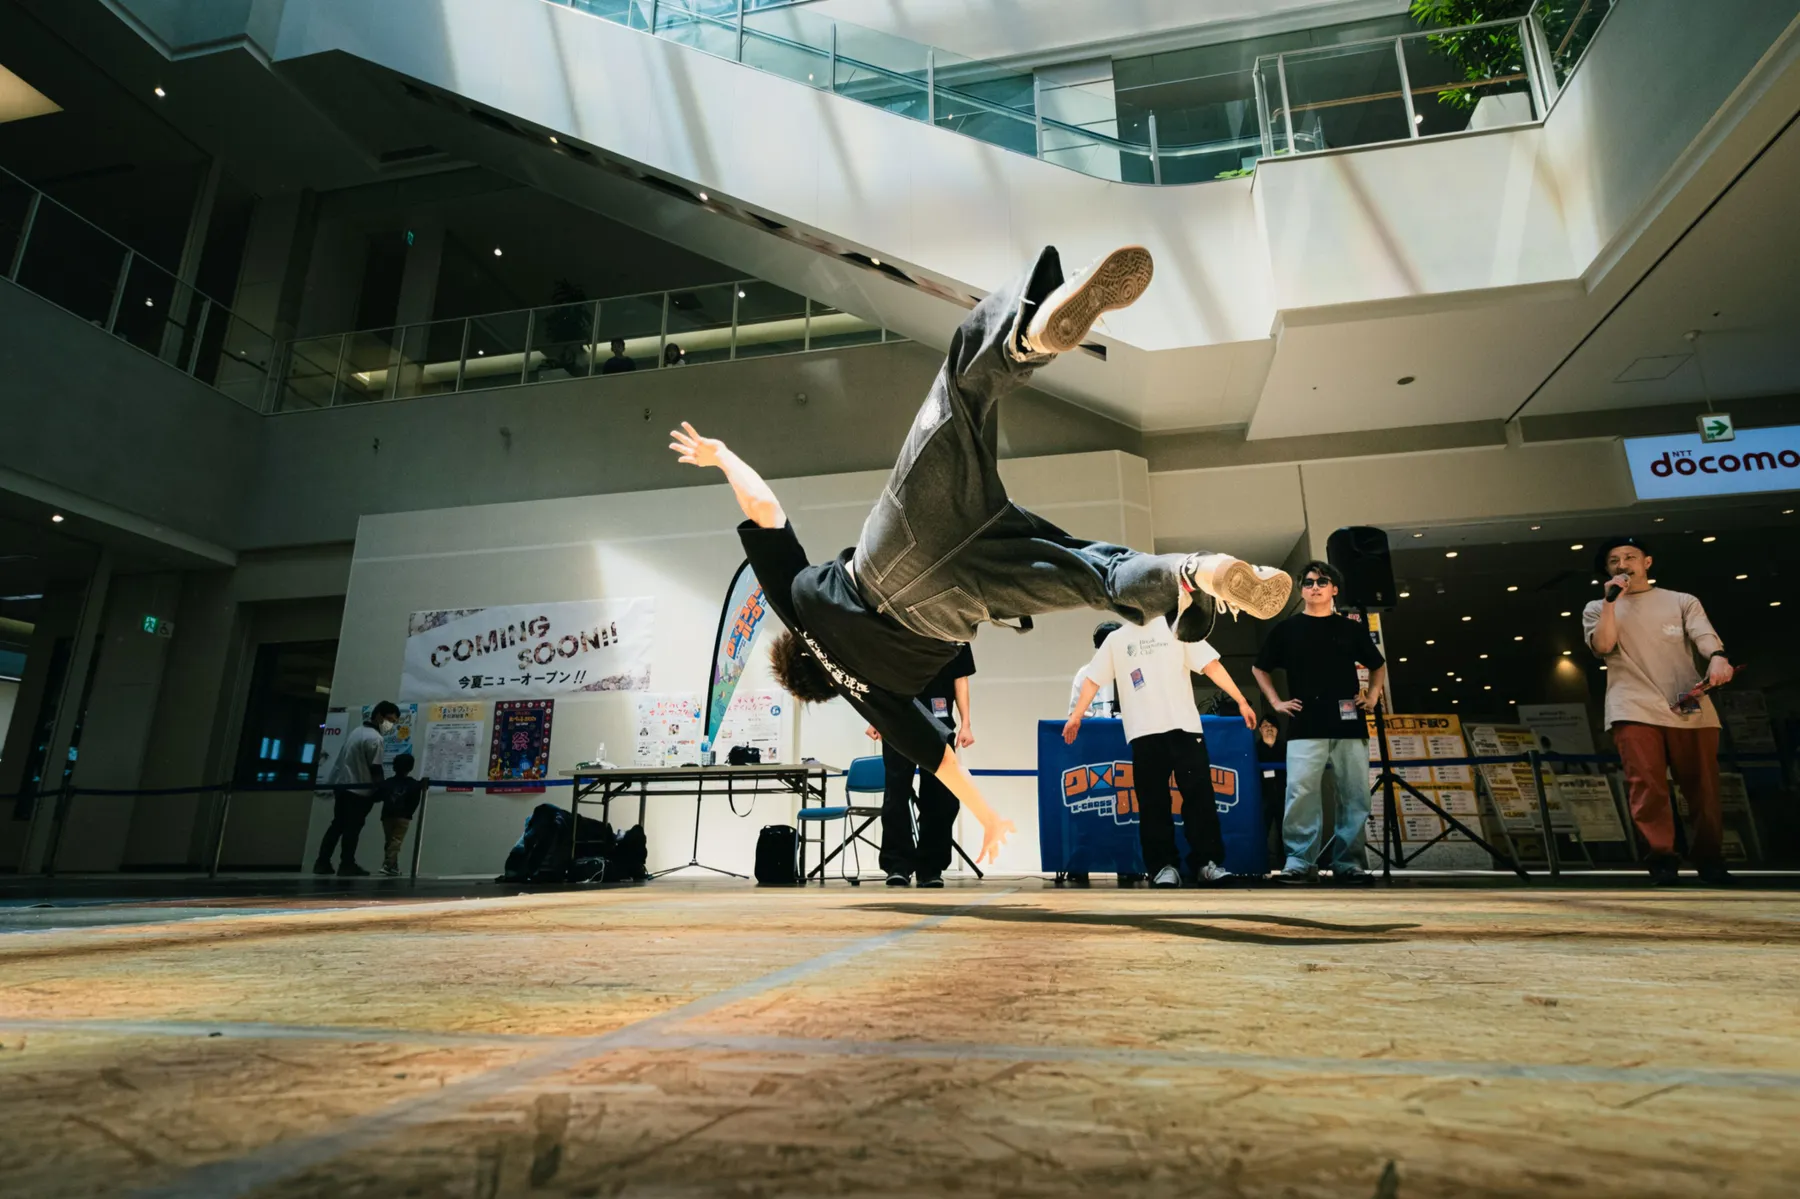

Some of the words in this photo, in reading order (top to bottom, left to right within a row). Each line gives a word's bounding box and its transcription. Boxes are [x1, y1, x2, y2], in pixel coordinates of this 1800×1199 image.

[1651, 450, 1800, 477] docomo
[431, 616, 550, 668] COMING
[518, 622, 618, 670] SOON!!
[1073, 800, 1112, 811] X-CROSS
